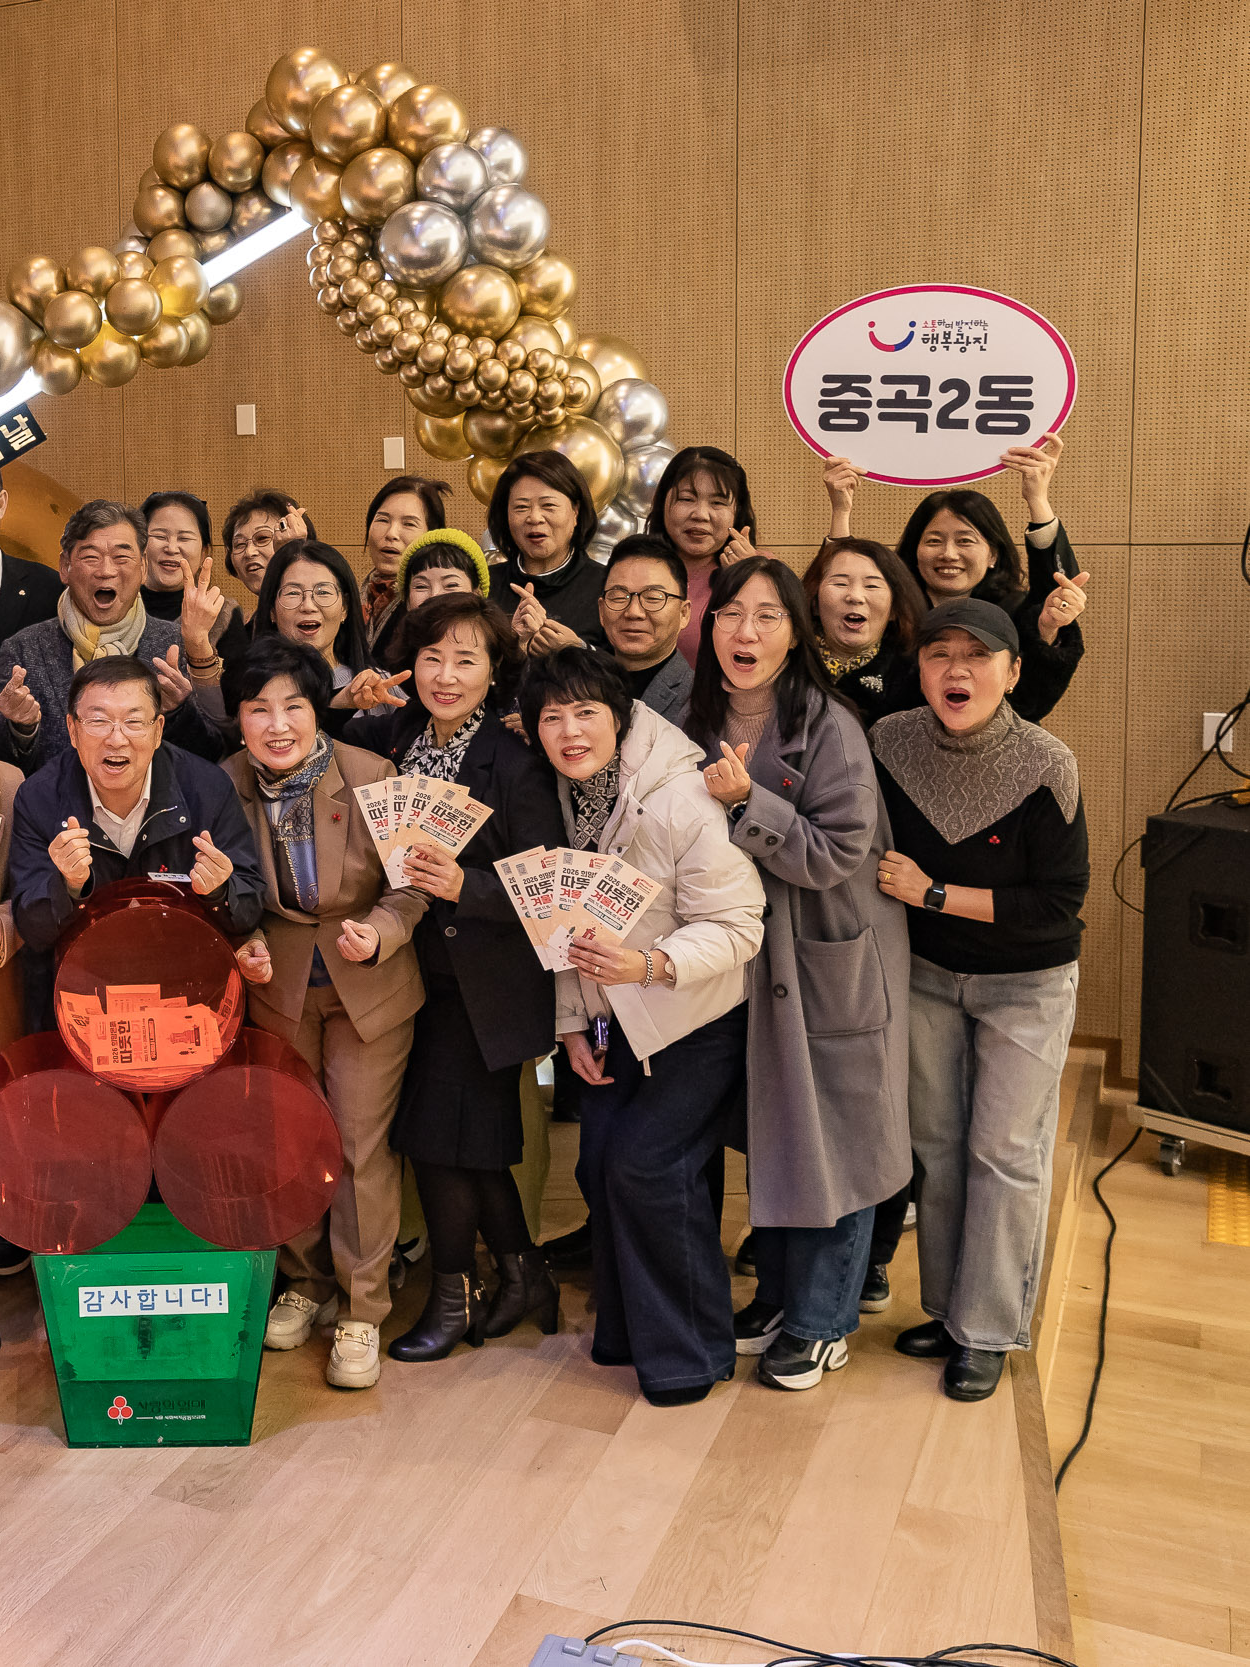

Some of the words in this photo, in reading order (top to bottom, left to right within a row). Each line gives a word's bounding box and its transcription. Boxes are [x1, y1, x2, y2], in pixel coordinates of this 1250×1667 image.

[922, 319, 954, 333] 소통하며
[955, 319, 989, 333] 발전하는
[921, 331, 988, 353] 행복광진
[817, 374, 1035, 436] 중곡2동
[438, 799, 454, 811] 2026
[431, 804, 473, 832] 따뜻한
[562, 867, 579, 876] 2026
[604, 873, 621, 887] 2026
[522, 876, 539, 885] 2026
[524, 878, 555, 897] 따뜻
[560, 874, 591, 890] 따뜻
[530, 893, 554, 907] 겨울
[559, 887, 582, 900] 겨울
[596, 878, 641, 913] 따뜻한
[590, 889, 633, 921] 겨울나기
[117, 1019, 133, 1064] 따뜻한
[112, 1047, 120, 1064] 2026
[82, 1287, 224, 1313] 감사합니다!
